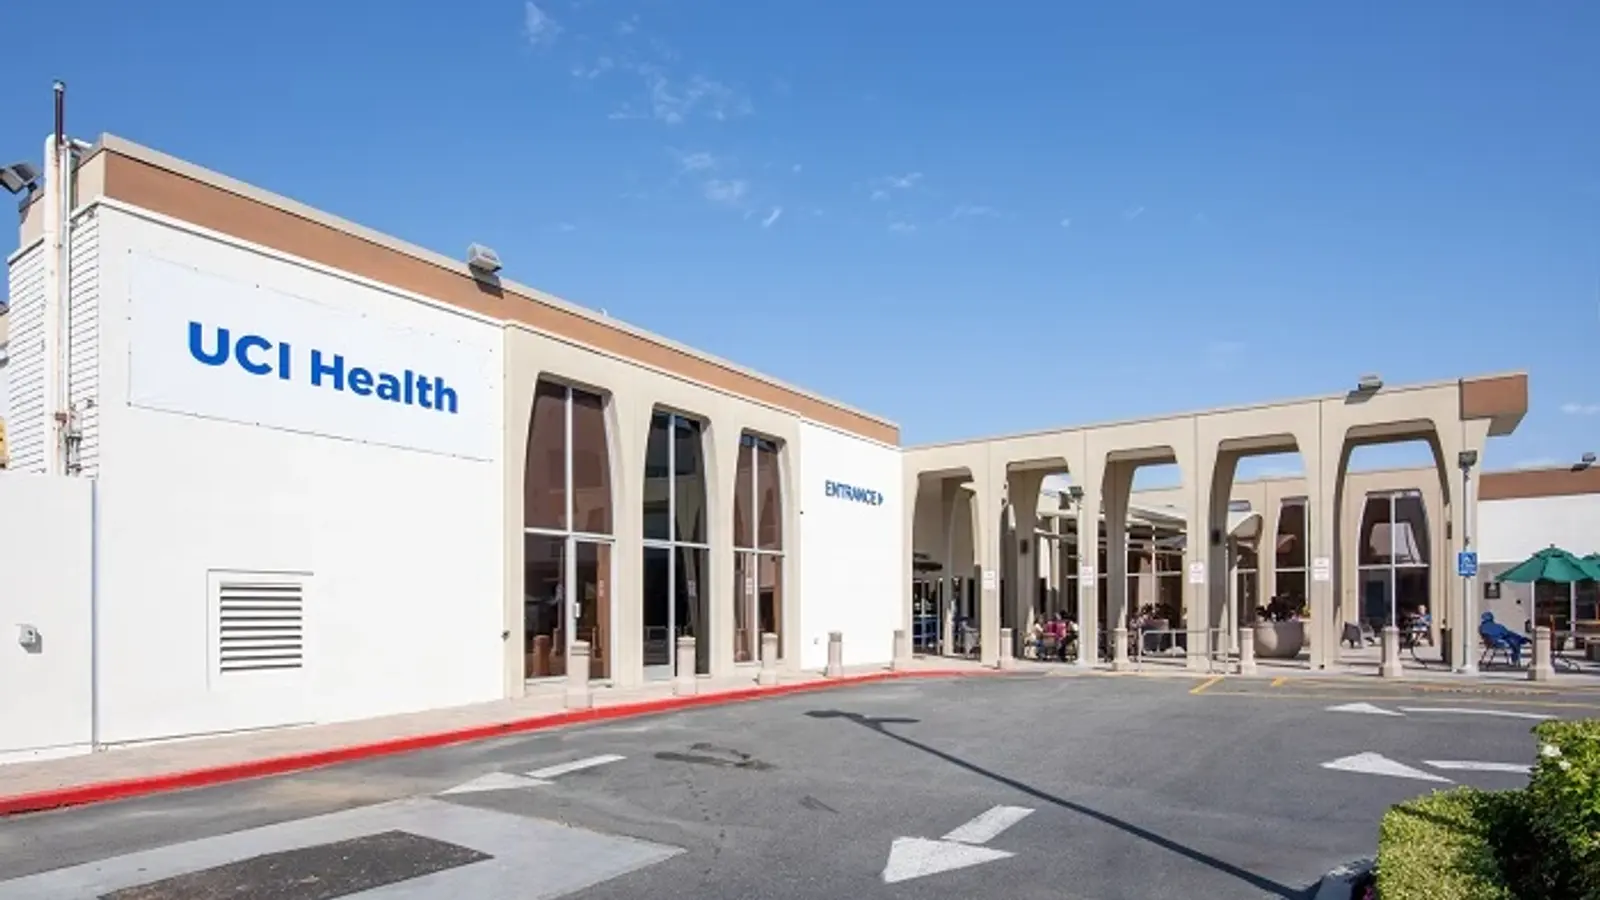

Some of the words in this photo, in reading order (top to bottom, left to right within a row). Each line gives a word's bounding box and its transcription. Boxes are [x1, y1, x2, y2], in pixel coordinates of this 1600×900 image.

[188, 321, 291, 380] UCI
[310, 349, 458, 414] Health
[825, 480, 877, 506] ENTRANCE
